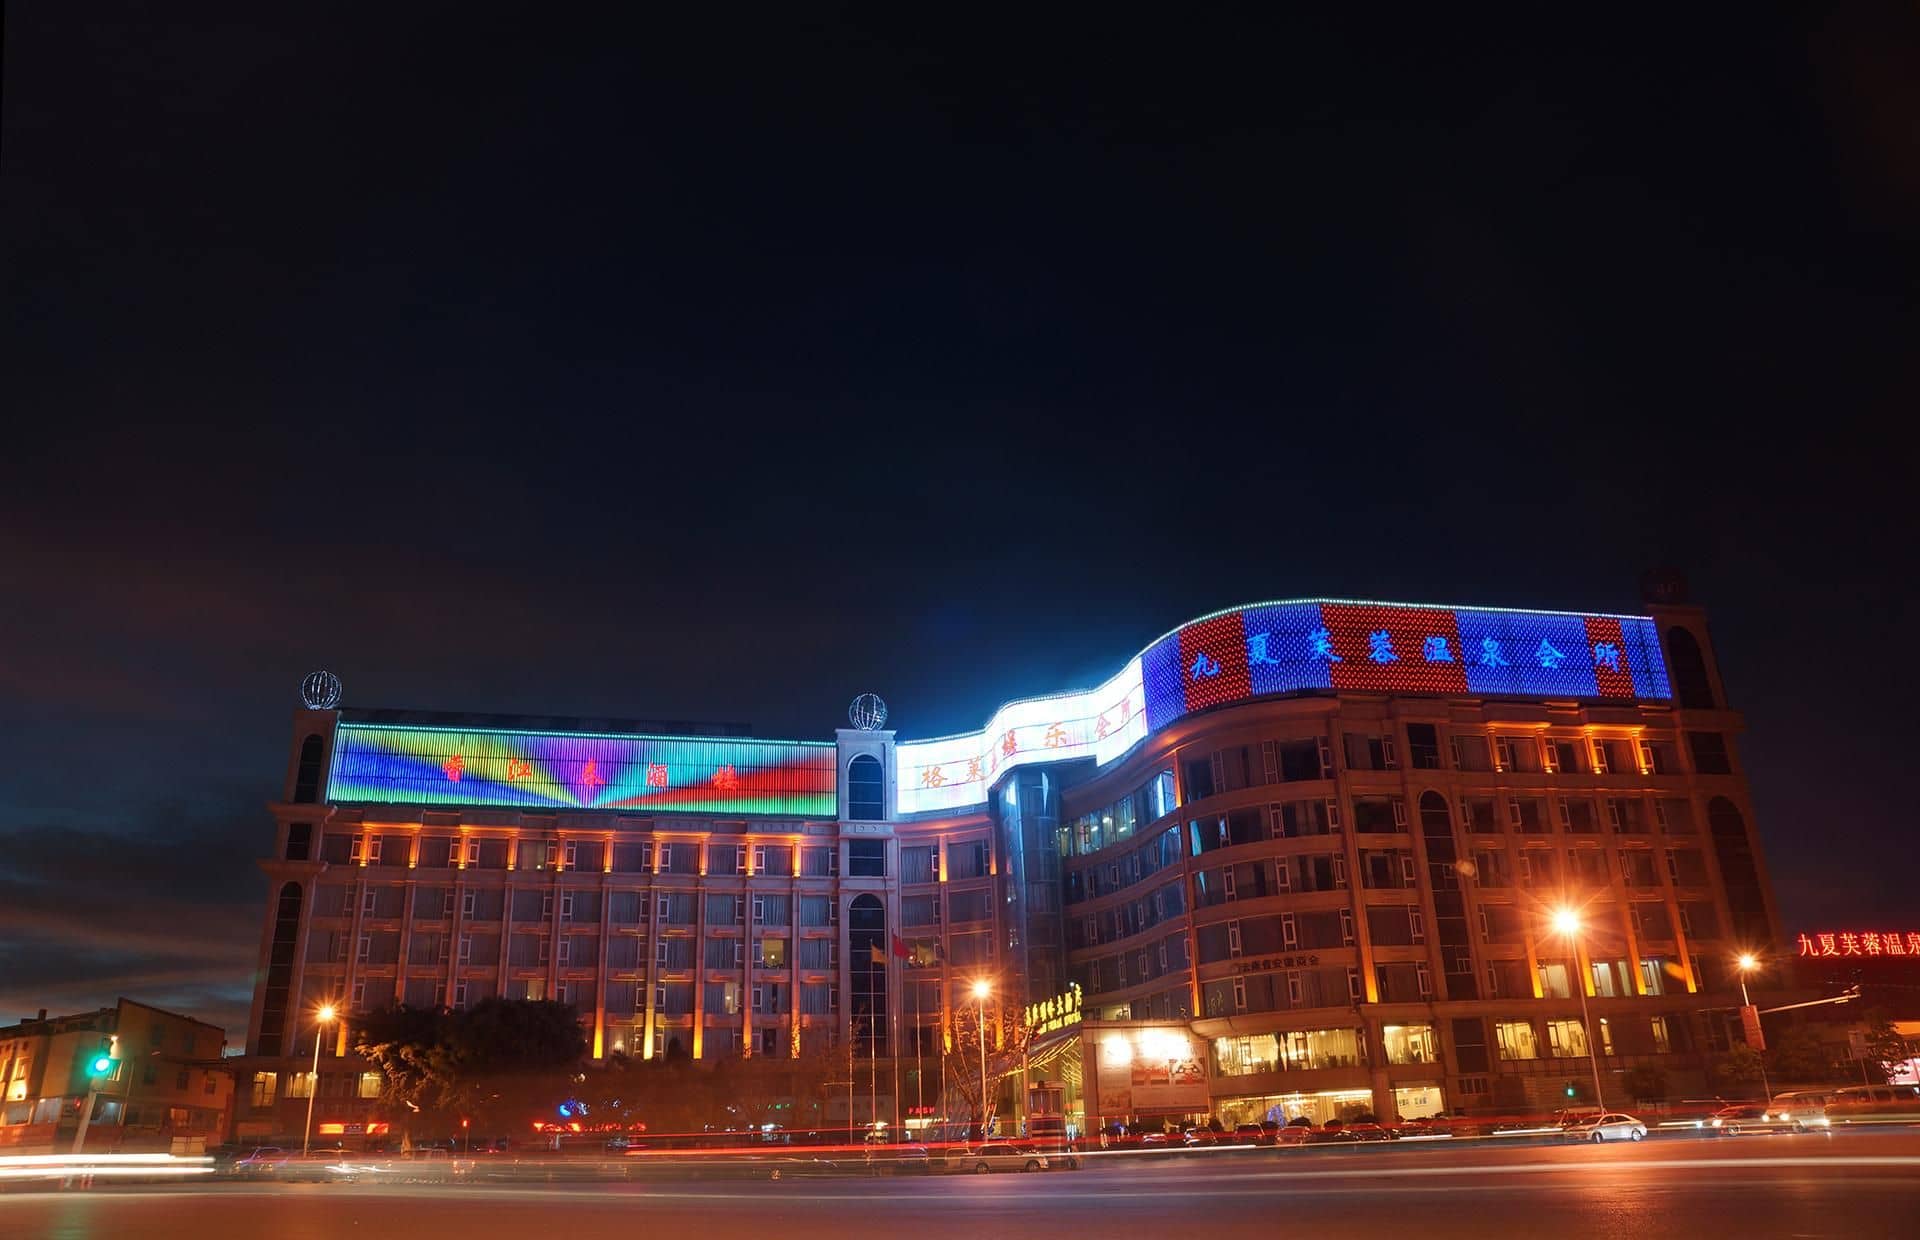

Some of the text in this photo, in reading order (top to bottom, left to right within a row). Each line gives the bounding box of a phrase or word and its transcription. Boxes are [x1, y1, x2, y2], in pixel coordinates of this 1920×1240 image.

[1190, 629, 1620, 680] 九夏芙蓉温泉会所
